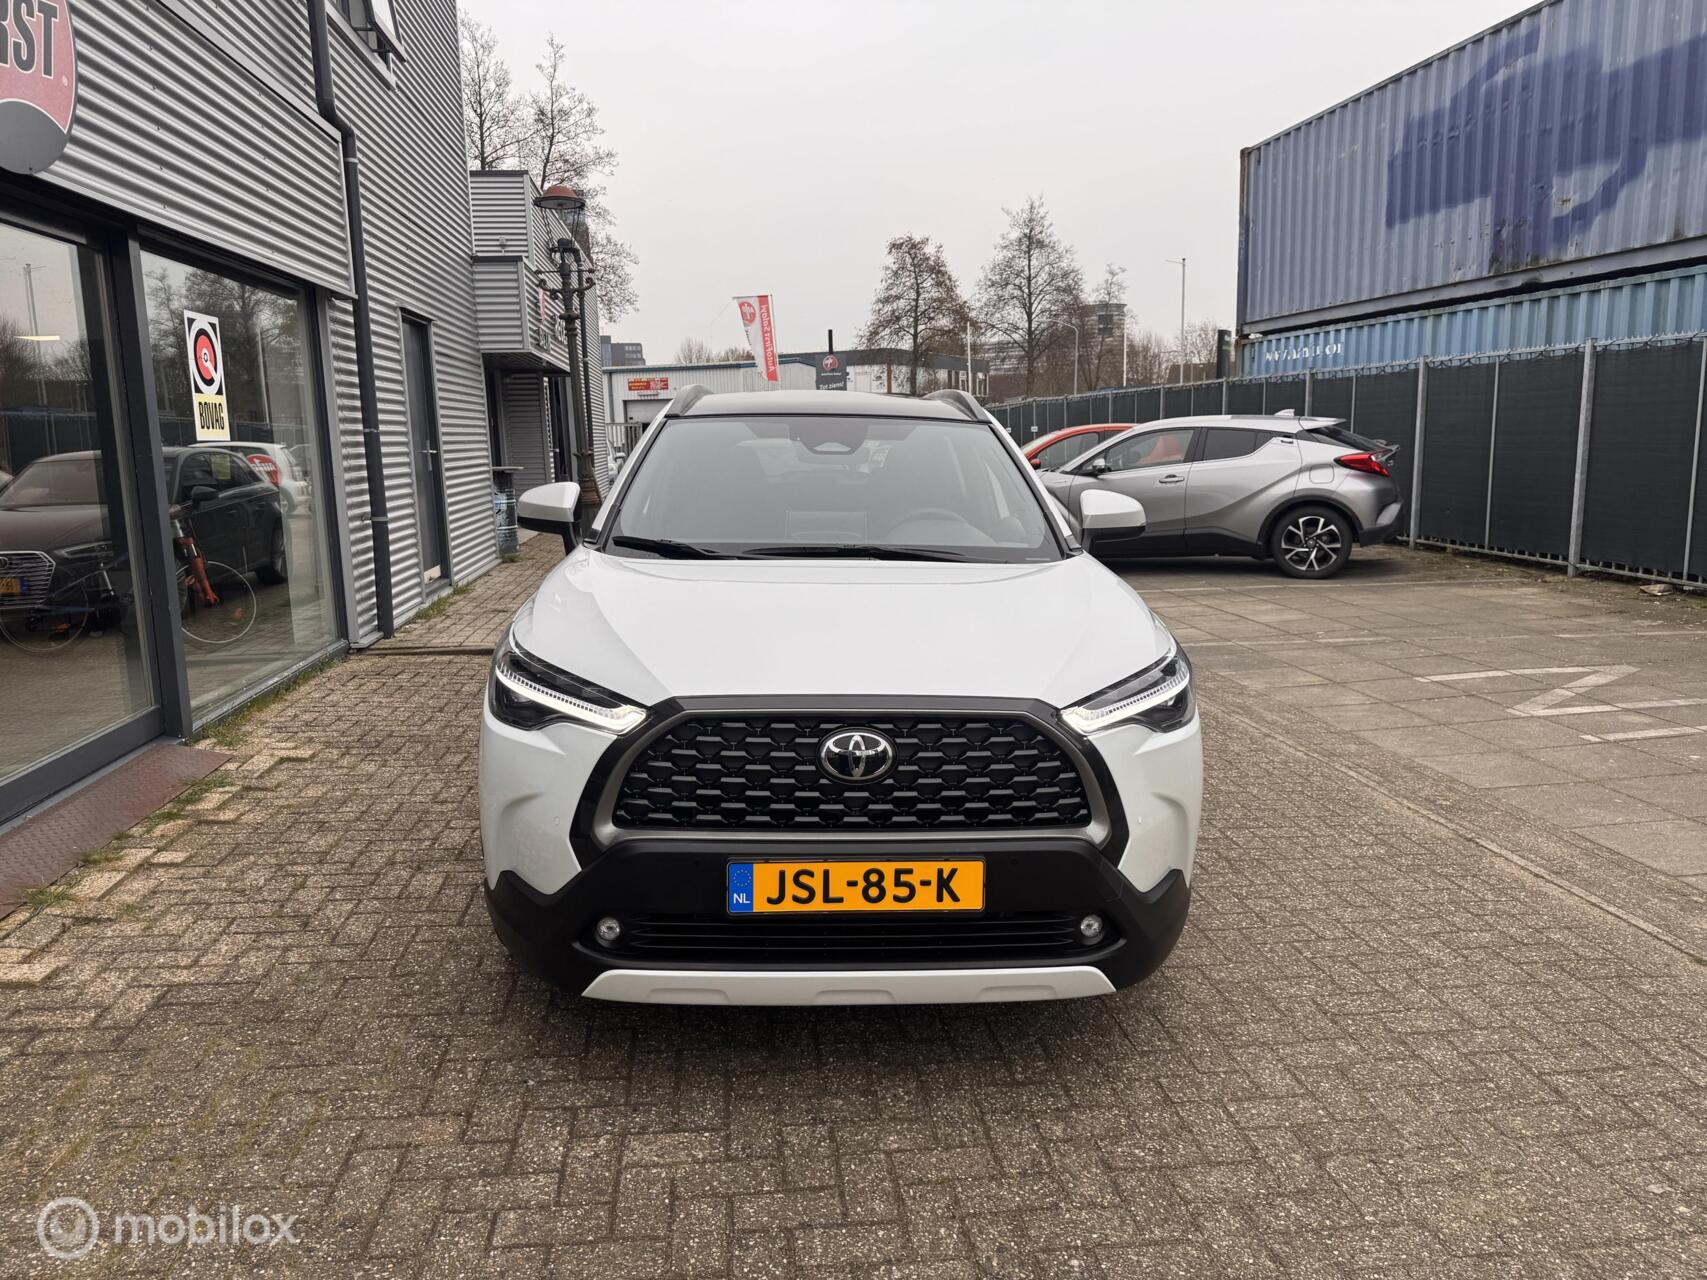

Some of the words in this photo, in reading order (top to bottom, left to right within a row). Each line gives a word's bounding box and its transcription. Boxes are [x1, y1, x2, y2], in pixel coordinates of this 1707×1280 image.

[198, 401, 225, 430] BOVAG
[733, 893, 750, 904] NL
[766, 867, 961, 905] JSL-85-K
